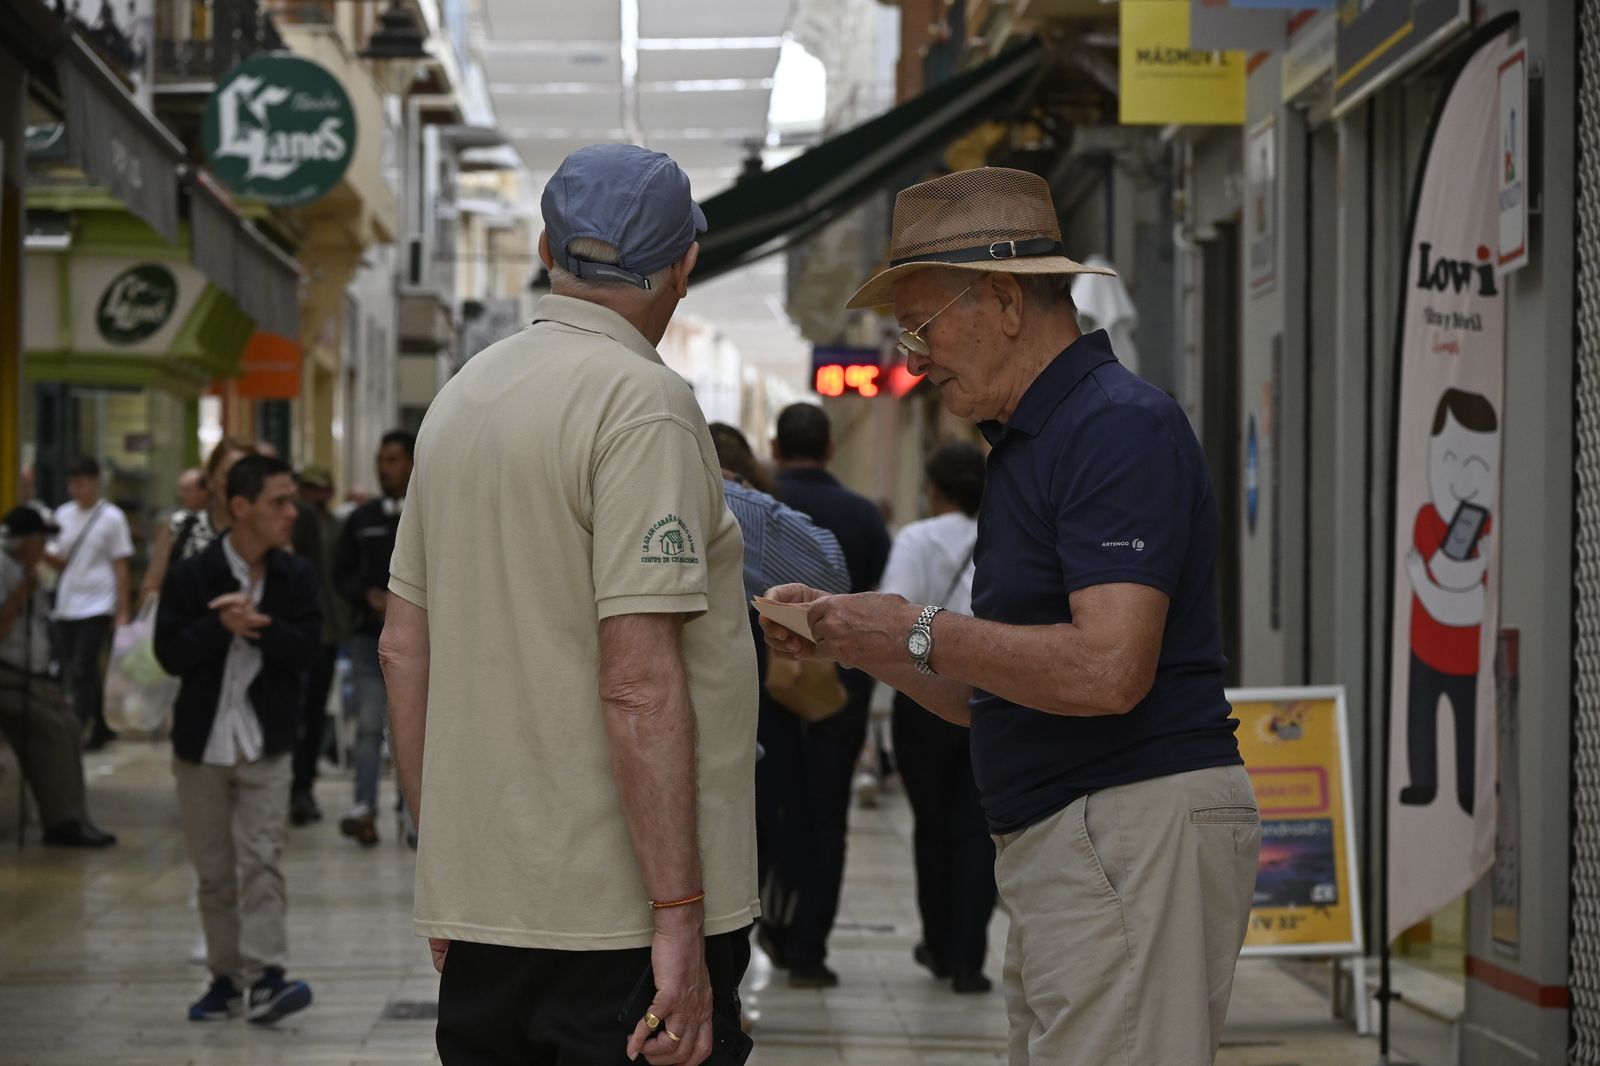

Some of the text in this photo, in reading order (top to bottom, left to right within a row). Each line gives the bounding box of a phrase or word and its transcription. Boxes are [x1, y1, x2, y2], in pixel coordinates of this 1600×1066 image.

[1417, 241, 1498, 297] Lowi
[653, 513, 678, 530] CABAÑA
[643, 527, 657, 545] GRAN
[642, 544, 650, 553] LA
